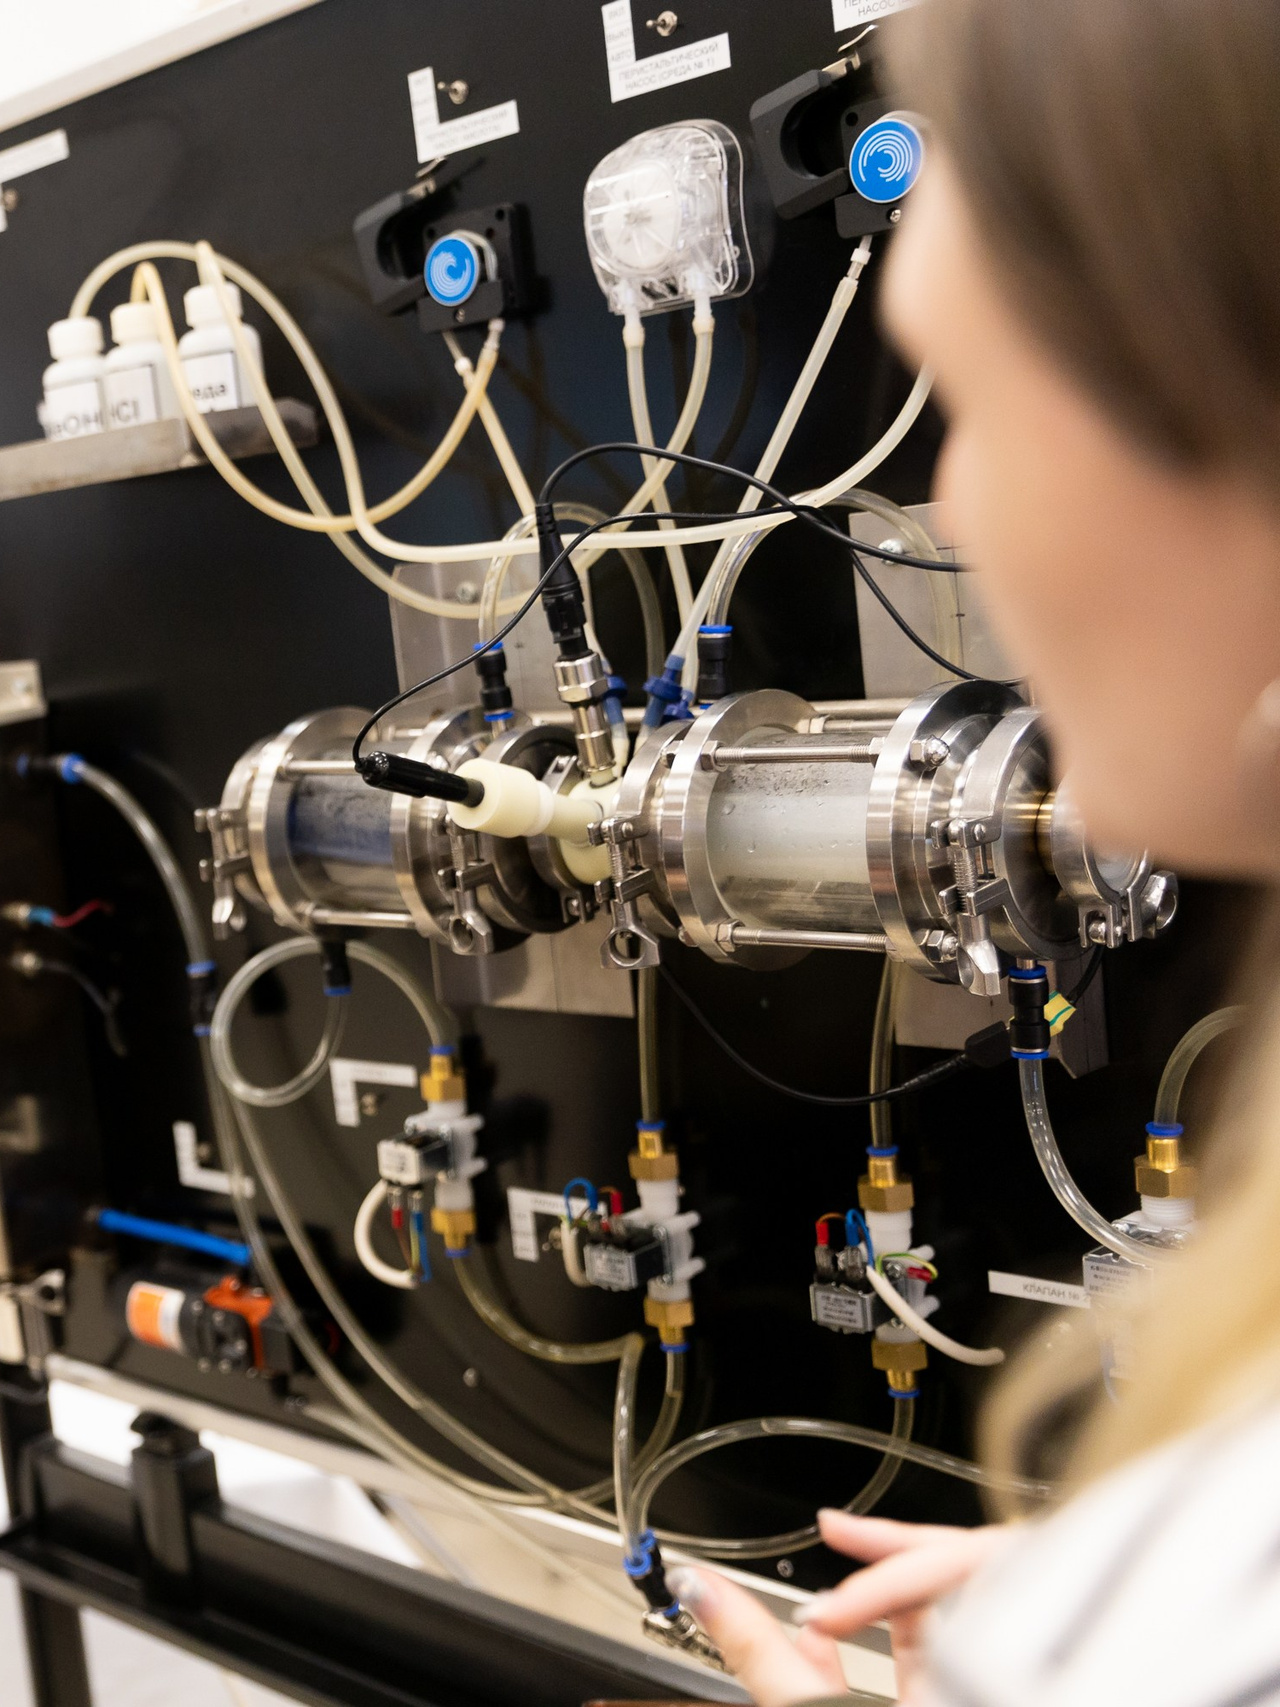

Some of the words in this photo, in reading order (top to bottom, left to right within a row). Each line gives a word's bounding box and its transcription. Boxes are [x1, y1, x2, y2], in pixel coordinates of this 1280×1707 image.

[857, 0, 895, 17] НАСОС
[625, 75, 657, 91] НАСОС
[188, 383, 228, 400] еда
[1022, 1281, 1066, 1299] КЛАПАН
